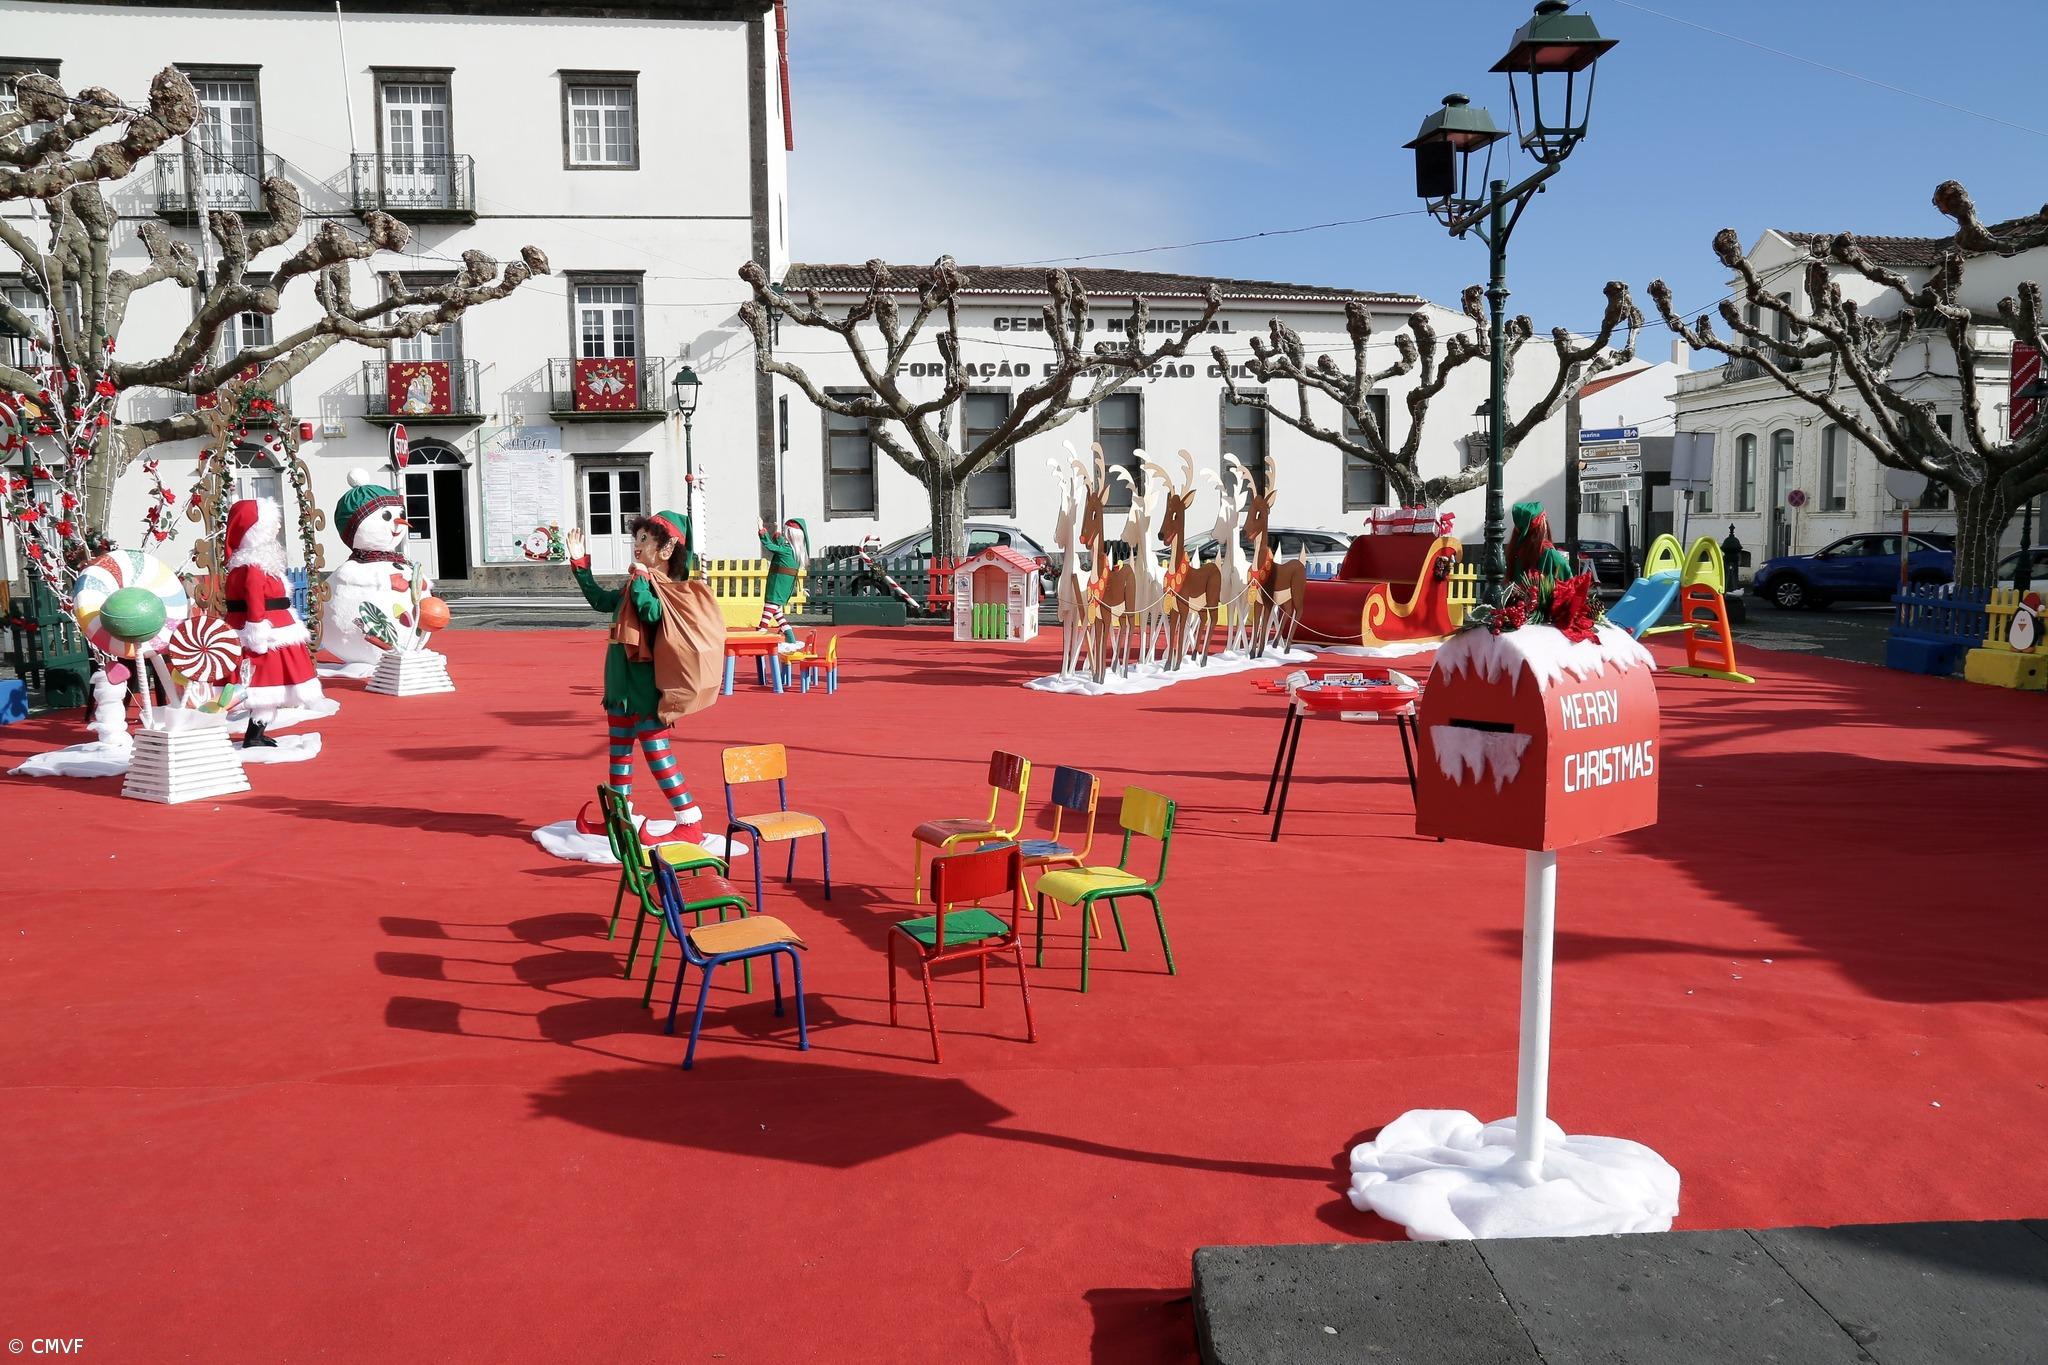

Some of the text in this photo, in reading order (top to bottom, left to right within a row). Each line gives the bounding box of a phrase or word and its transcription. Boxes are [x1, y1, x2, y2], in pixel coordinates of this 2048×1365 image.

[1107, 318, 1237, 334] MNICIAL
[896, 360, 1031, 383] FORAÇÃO
[396, 438, 408, 455] STOP
[1560, 689, 1619, 731] MERRY
[1564, 740, 1654, 793] CHRISTMAS
